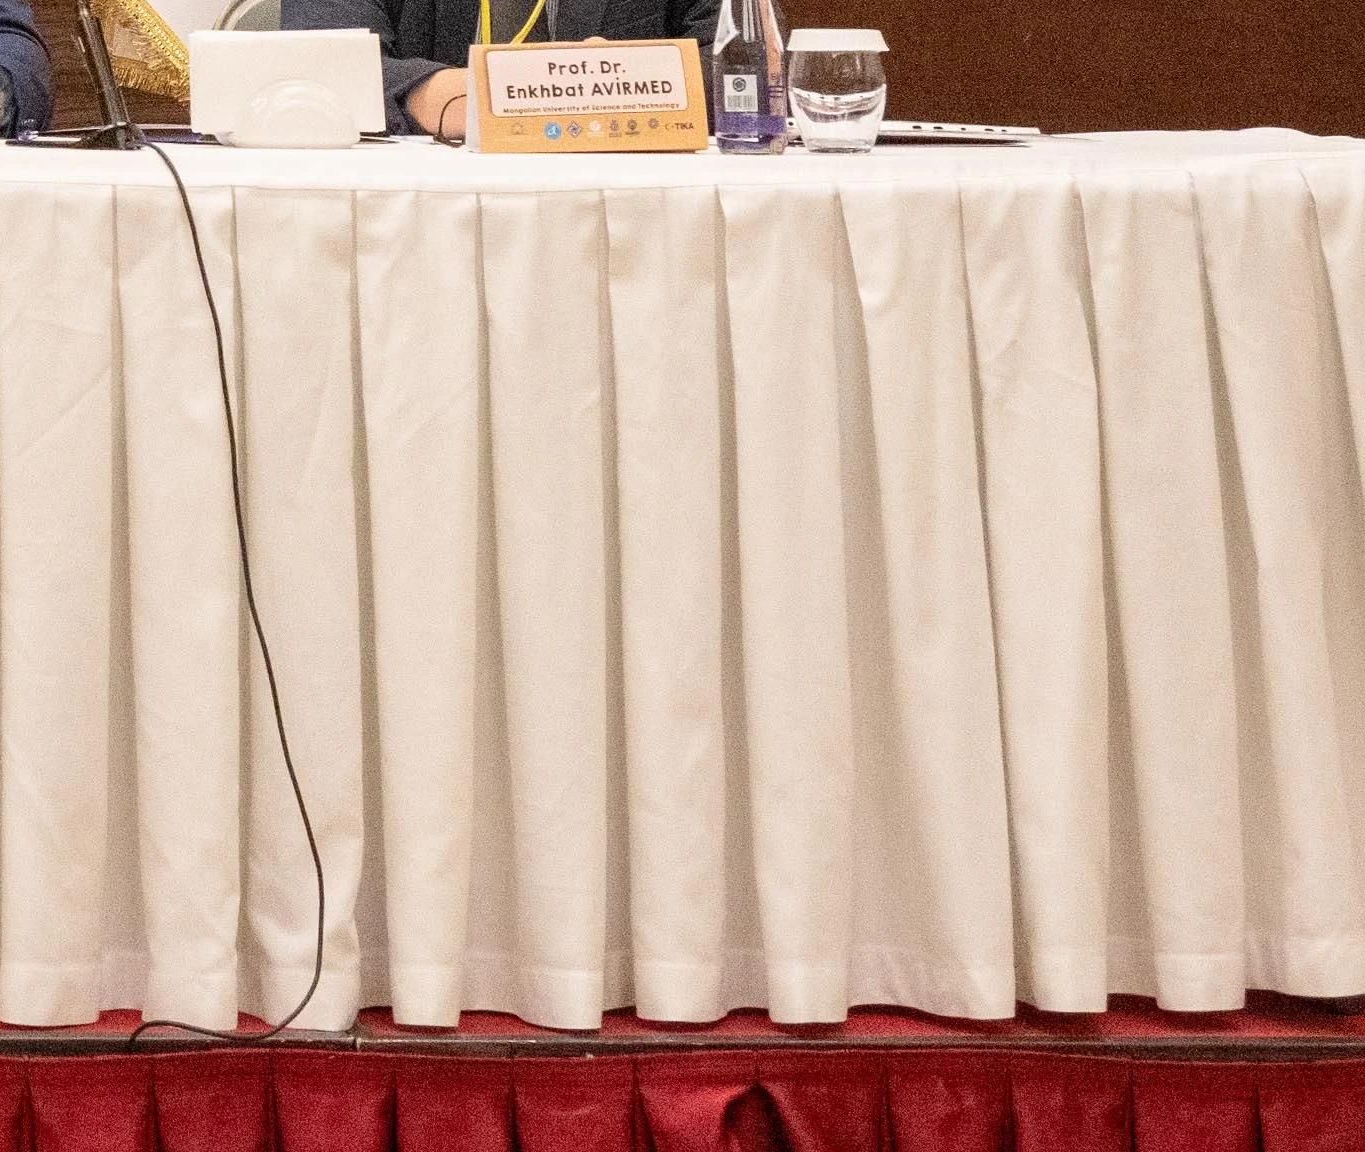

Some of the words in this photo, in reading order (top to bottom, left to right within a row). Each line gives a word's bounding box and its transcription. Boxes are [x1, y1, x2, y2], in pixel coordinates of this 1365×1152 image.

[548, 60, 595, 76] Prof.
[600, 60, 626, 74] Dr.
[506, 83, 584, 99] Enkhbat
[591, 77, 673, 97] AVİRMED
[543, 105, 580, 113] University
